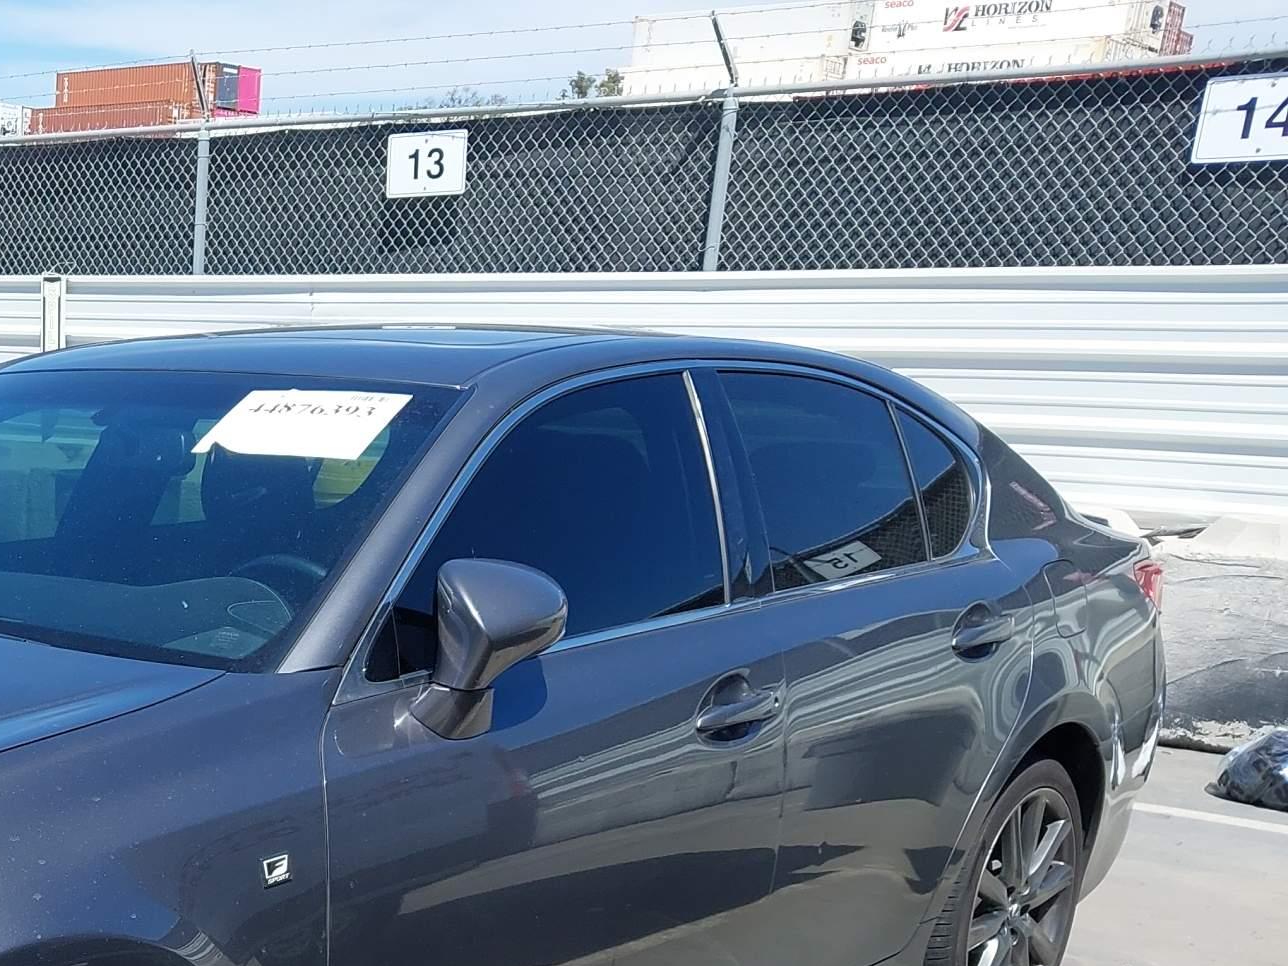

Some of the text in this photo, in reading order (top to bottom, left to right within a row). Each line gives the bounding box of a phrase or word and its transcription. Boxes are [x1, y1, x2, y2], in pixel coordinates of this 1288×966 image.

[974, 0, 1053, 17] HORIZON
[971, 15, 1039, 27] LINES
[857, 55, 887, 66] seaco
[408, 148, 445, 180] 13
[249, 402, 377, 418] 44876393
